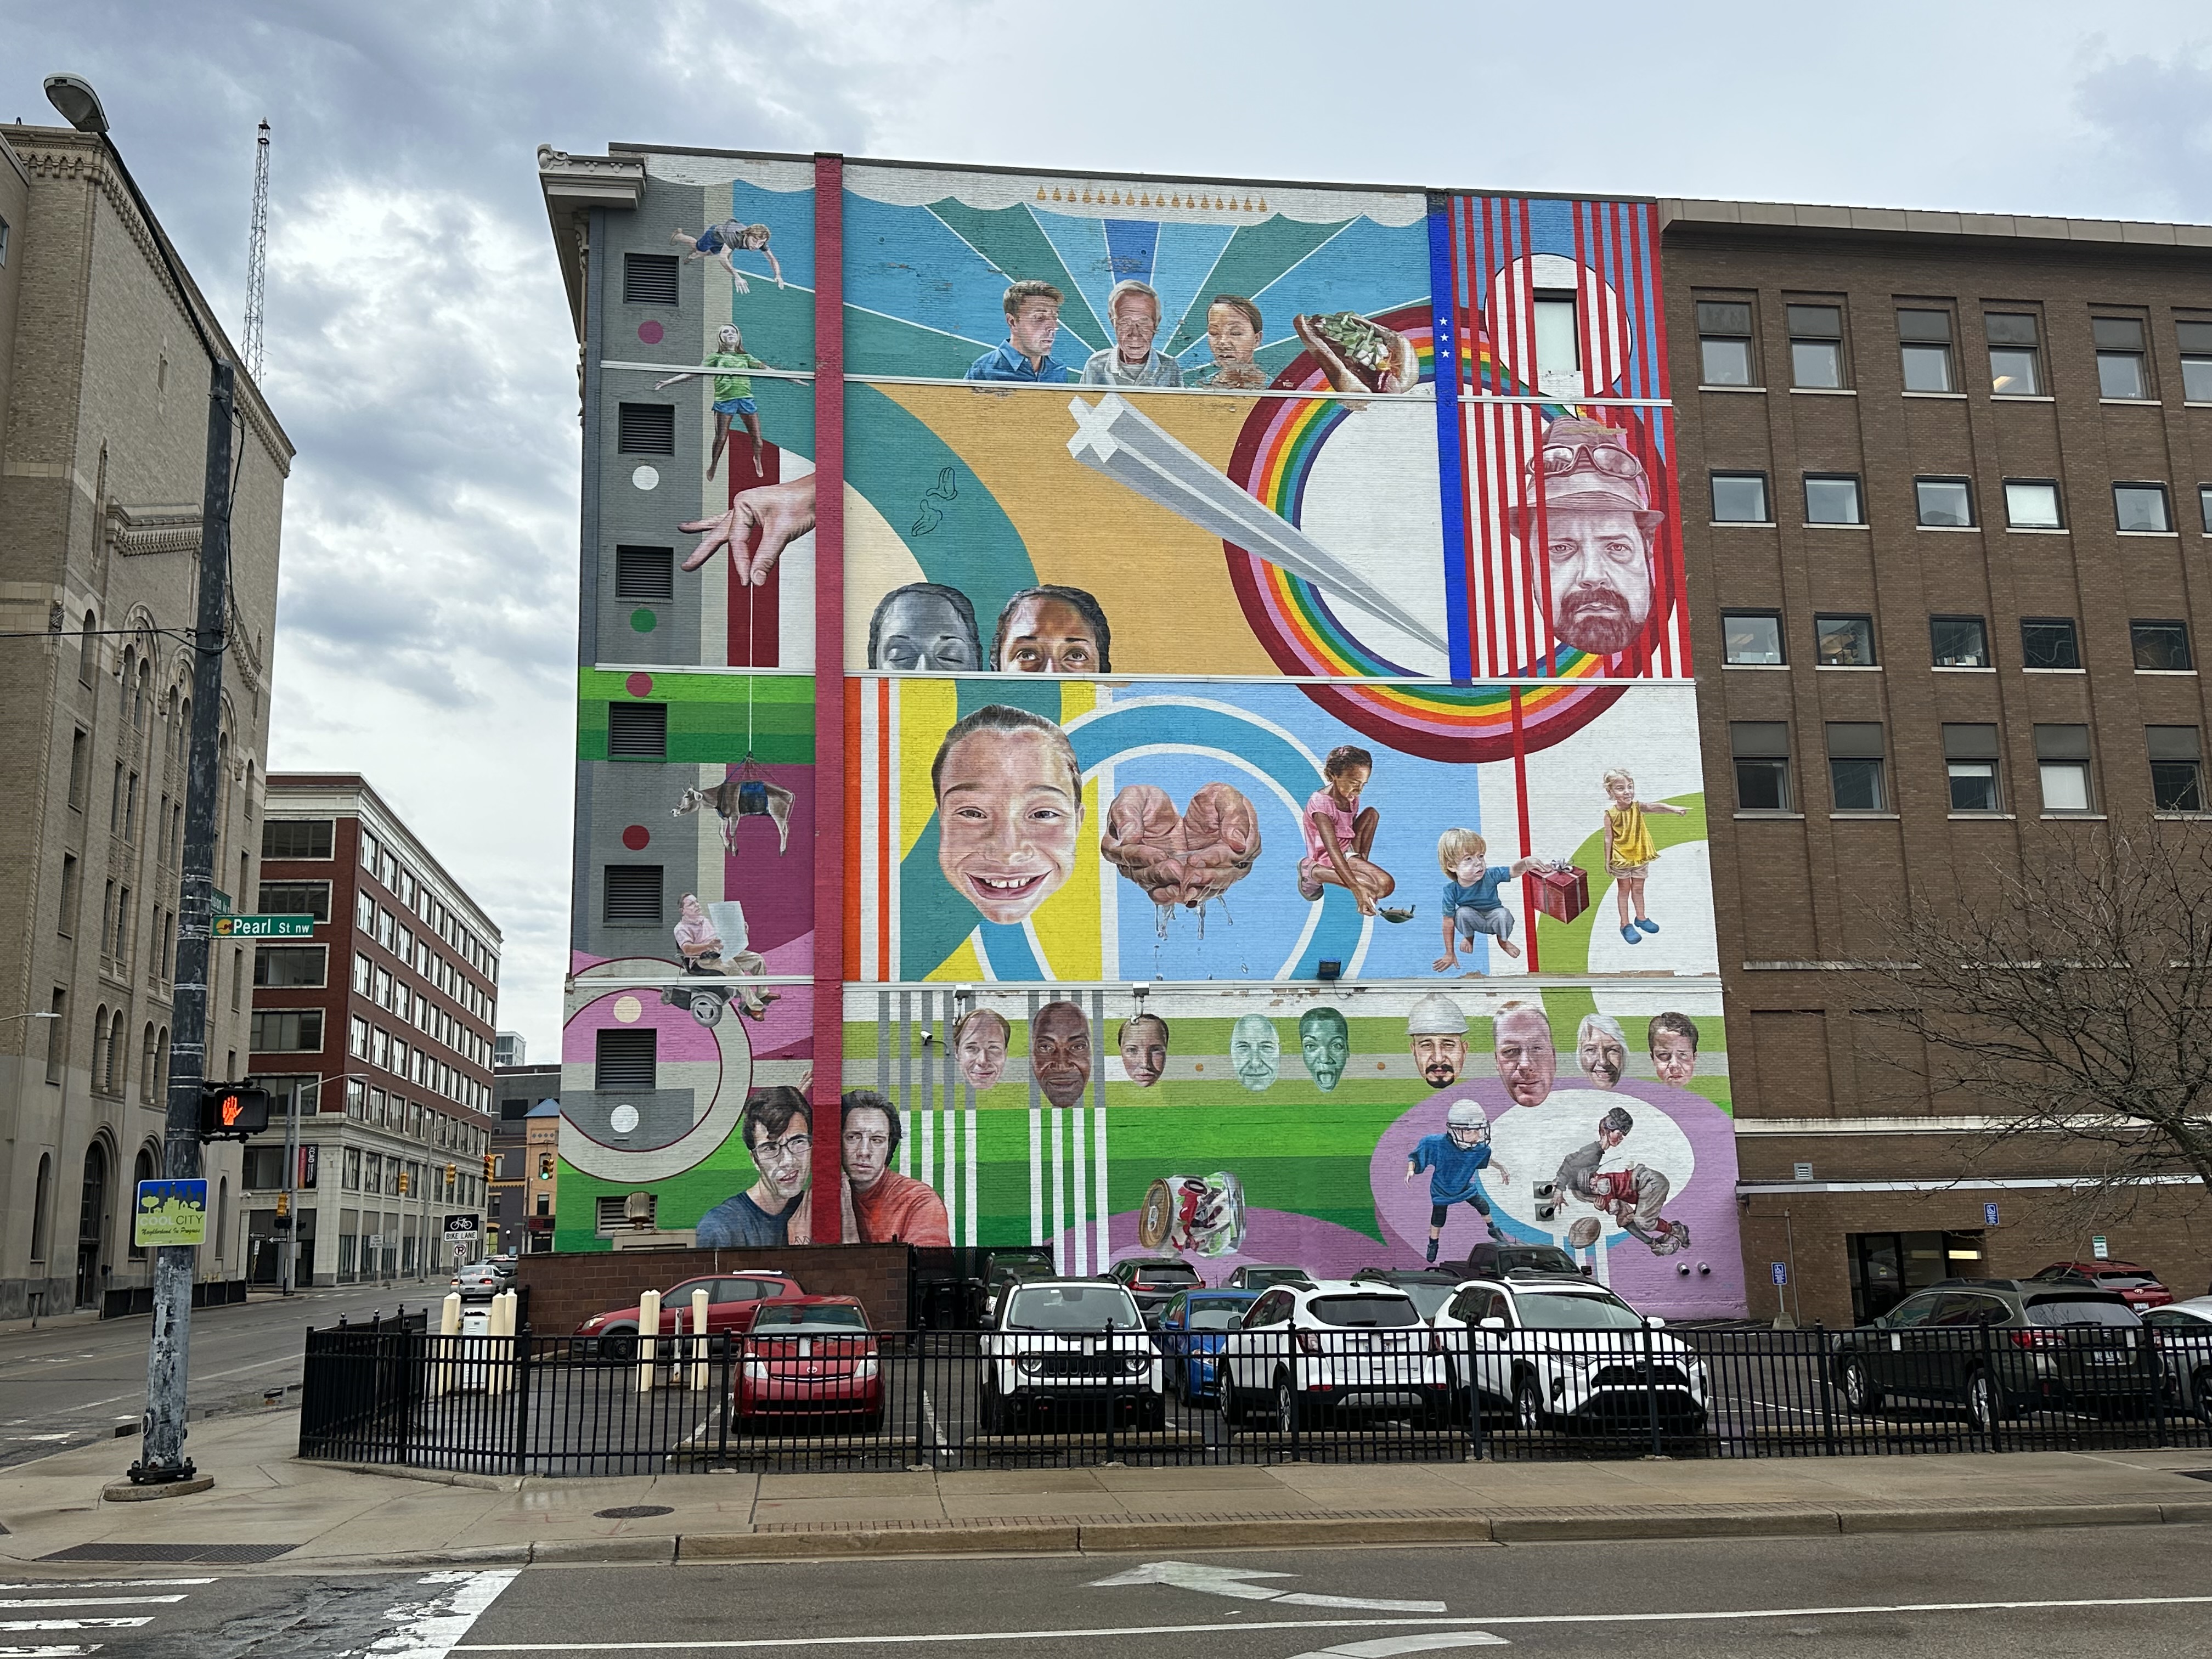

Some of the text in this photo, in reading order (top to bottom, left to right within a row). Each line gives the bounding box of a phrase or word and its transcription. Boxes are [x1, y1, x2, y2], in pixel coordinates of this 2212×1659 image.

[234, 918, 310, 934] Pearl St nw
[308, 1146, 317, 1163] KCAD
